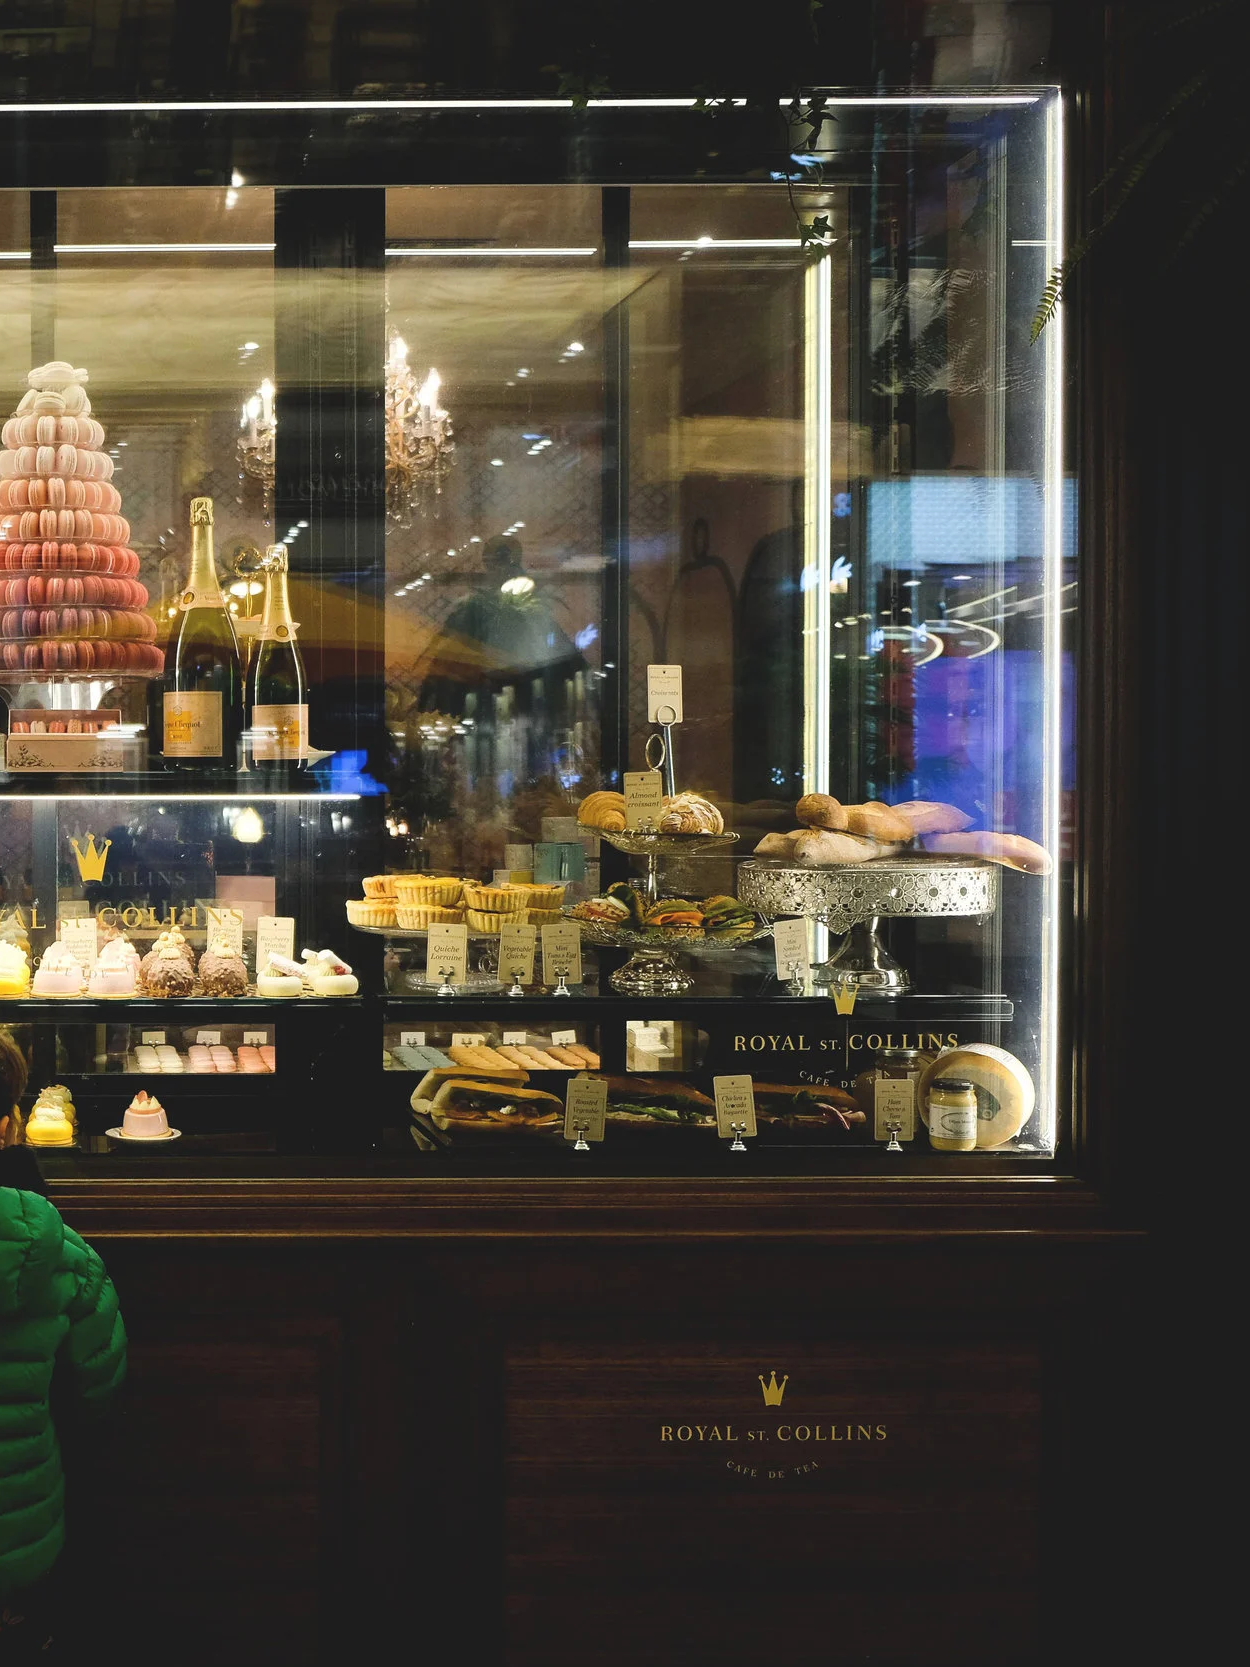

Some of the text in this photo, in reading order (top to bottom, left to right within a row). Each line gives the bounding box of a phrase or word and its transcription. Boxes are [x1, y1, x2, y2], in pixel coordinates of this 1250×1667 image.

[98, 905, 244, 929] COLLINS
[430, 953, 463, 961] Lorraine
[433, 944, 460, 952] Quiche
[505, 952, 528, 960] Quiche
[734, 1033, 959, 1052] ROYAL ST. COLLINS
[799, 1070, 830, 1087] CAFE
[841, 1080, 857, 1089] DE
[660, 1425, 887, 1442] ROYAL ST. COLLINS
[726, 1459, 819, 1479] CAFE DE TEA
